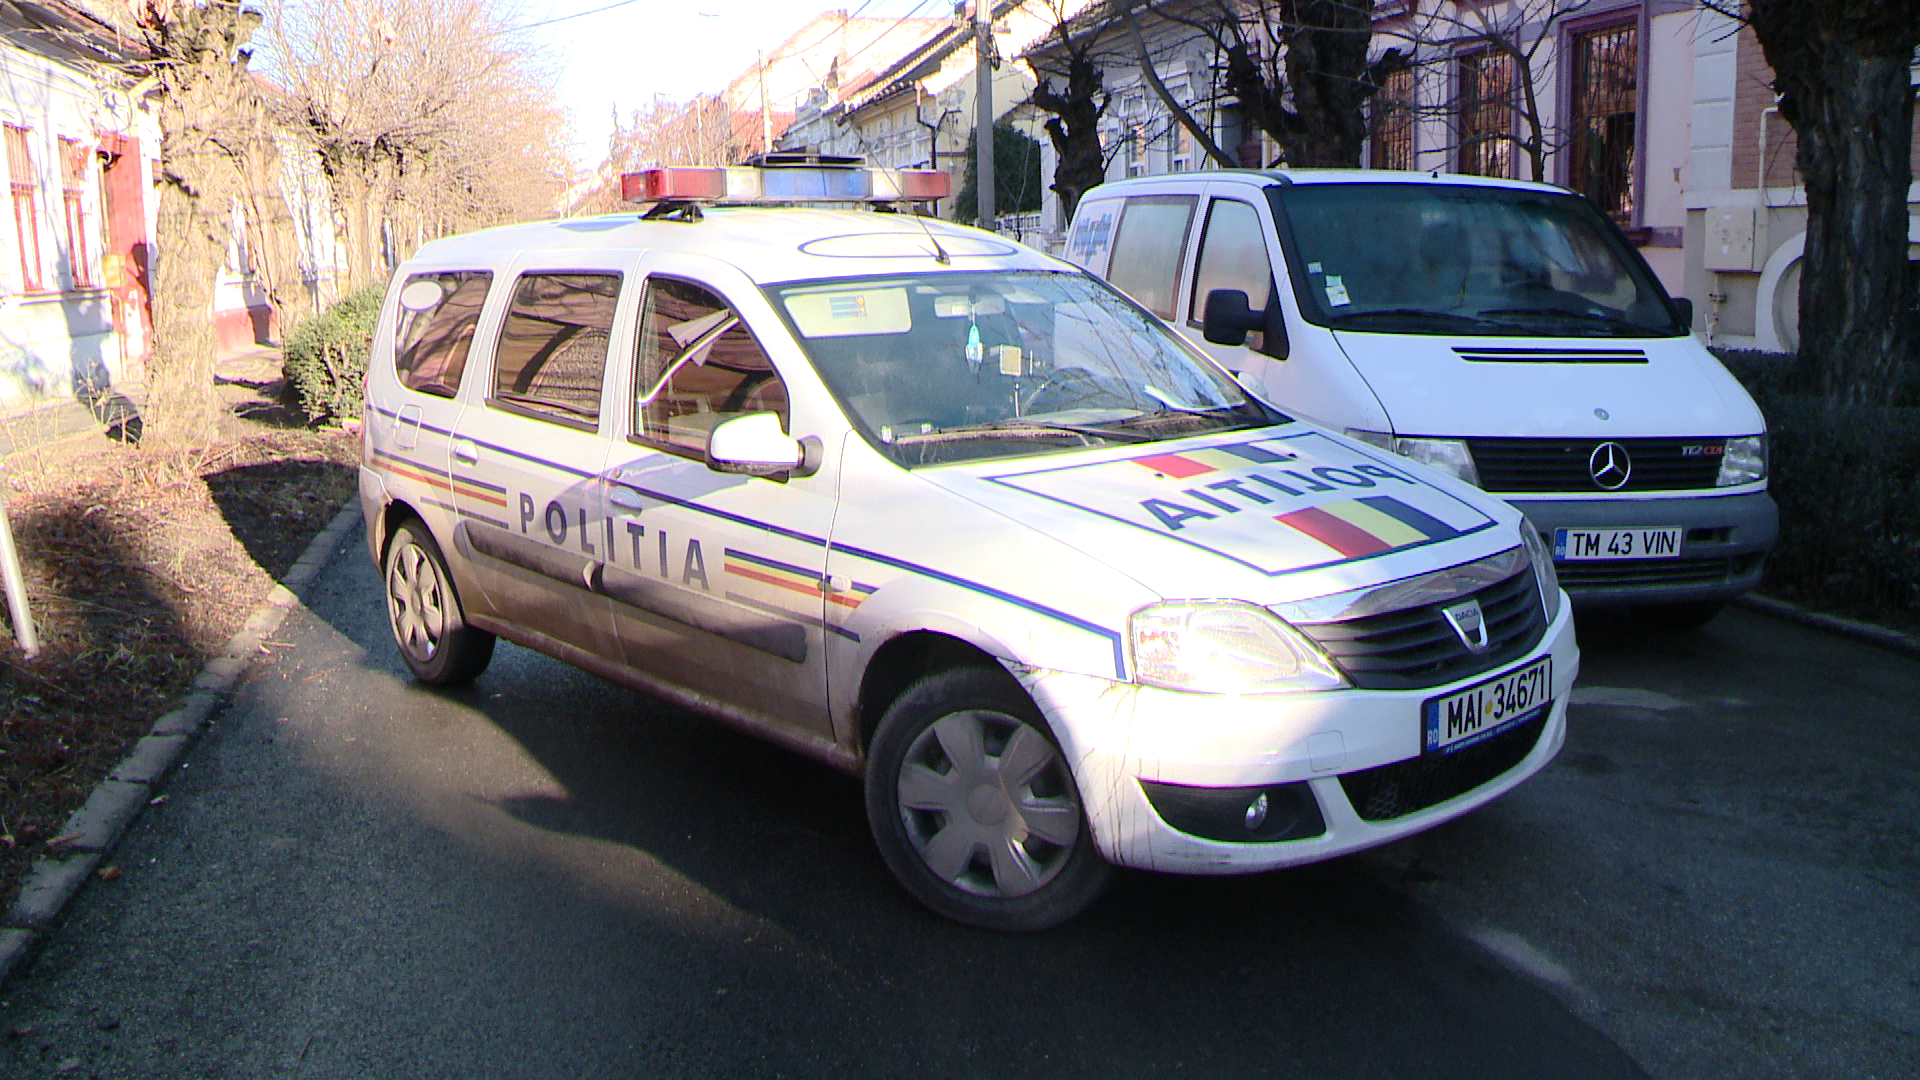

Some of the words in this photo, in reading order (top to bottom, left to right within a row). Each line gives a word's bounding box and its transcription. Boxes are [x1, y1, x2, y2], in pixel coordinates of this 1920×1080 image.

[520, 491, 710, 591] POLITIA
[1555, 545, 1565, 556] RO
[1573, 533, 1600, 556] TM
[1608, 531, 1633, 555] 43
[1643, 531, 1676, 555] VIN
[1447, 689, 1483, 739] MAI
[1493, 664, 1545, 720] 34671
[1427, 729, 1439, 747] RO
